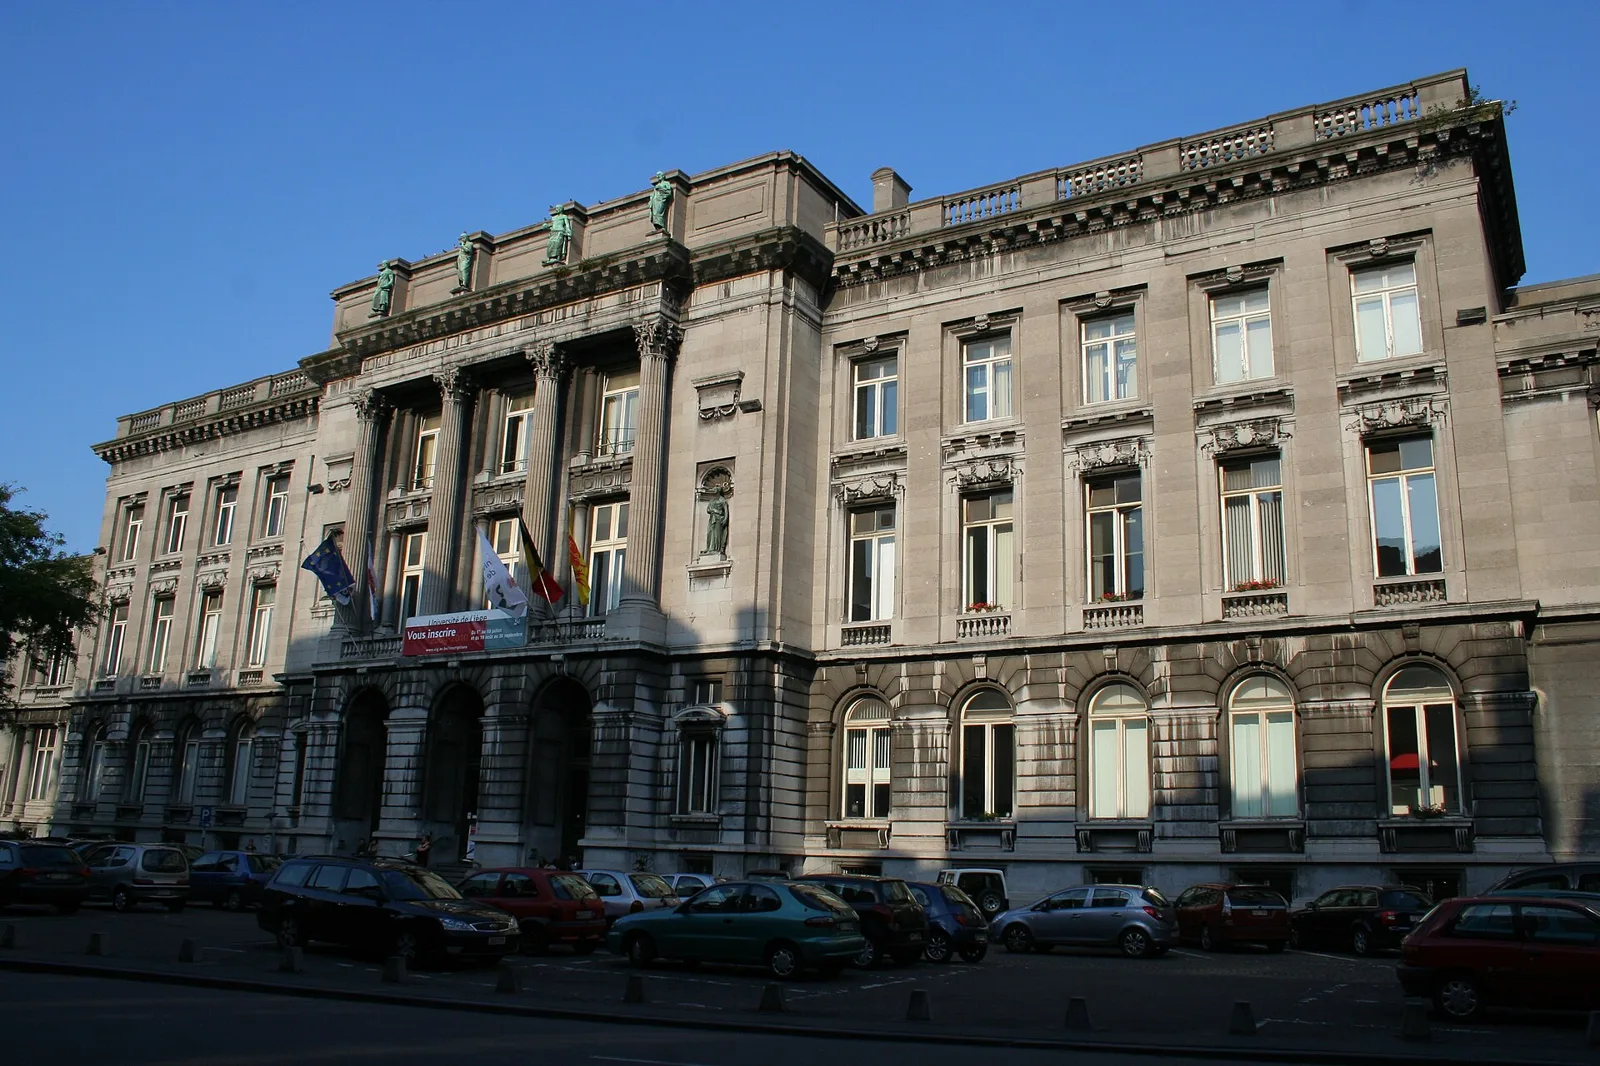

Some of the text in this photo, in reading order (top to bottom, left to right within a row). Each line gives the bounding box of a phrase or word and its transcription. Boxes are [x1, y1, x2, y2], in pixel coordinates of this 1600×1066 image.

[407, 627, 457, 640] Vous inscrire
[202, 809, 210, 820] P
